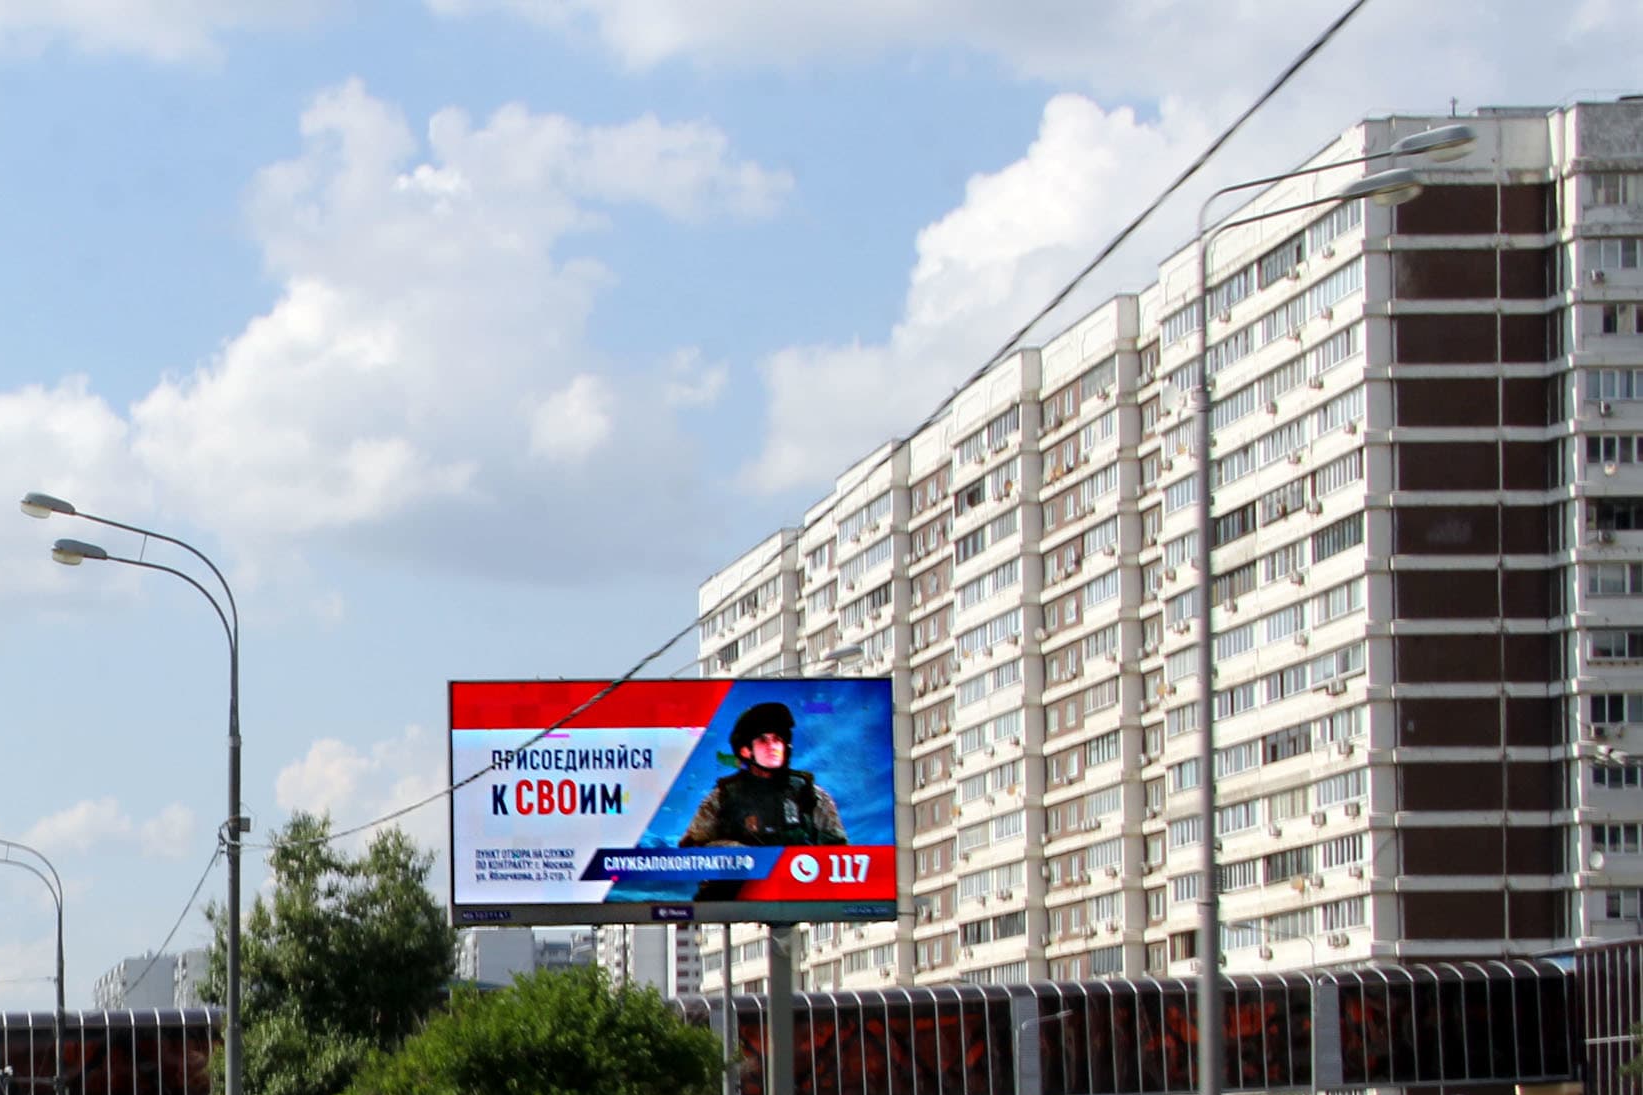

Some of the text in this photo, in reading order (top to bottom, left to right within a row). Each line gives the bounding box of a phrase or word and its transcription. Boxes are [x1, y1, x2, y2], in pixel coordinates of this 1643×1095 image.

[491, 744, 653, 772] ПРИСОЕДИНЯЙСЯ
[492, 785, 509, 815] К
[828, 854, 871, 883] 117
